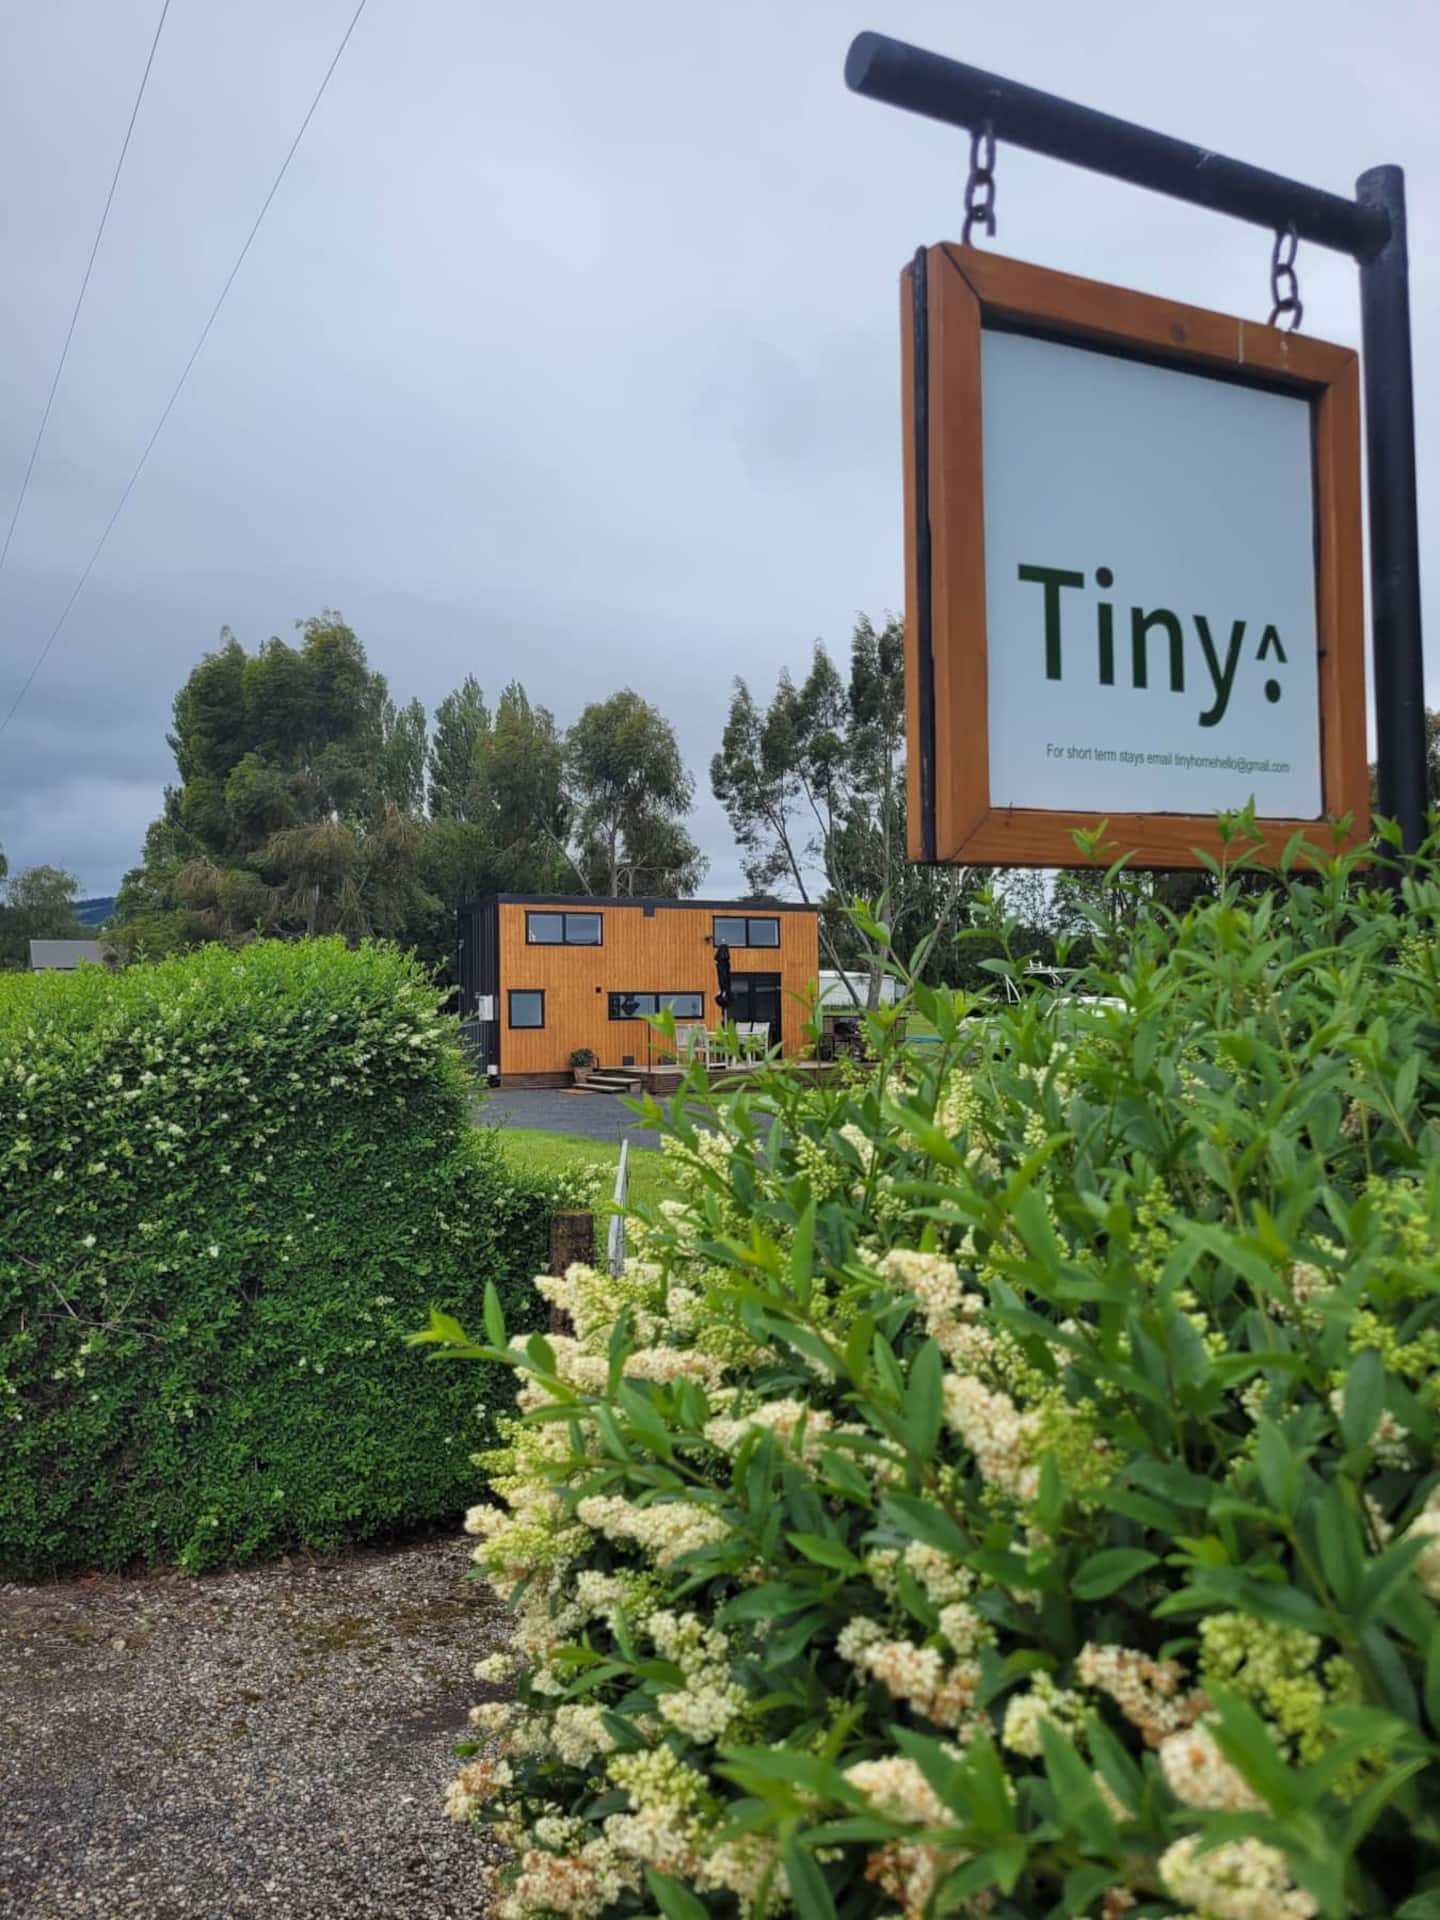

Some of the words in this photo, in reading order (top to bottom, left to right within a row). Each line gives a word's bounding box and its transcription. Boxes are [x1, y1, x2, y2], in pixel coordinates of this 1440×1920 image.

[1046, 743, 1064, 758] For
[1066, 745, 1092, 761] short
[1094, 748, 1116, 762] term
[1119, 750, 1144, 767] stays
[1146, 752, 1173, 766] email
